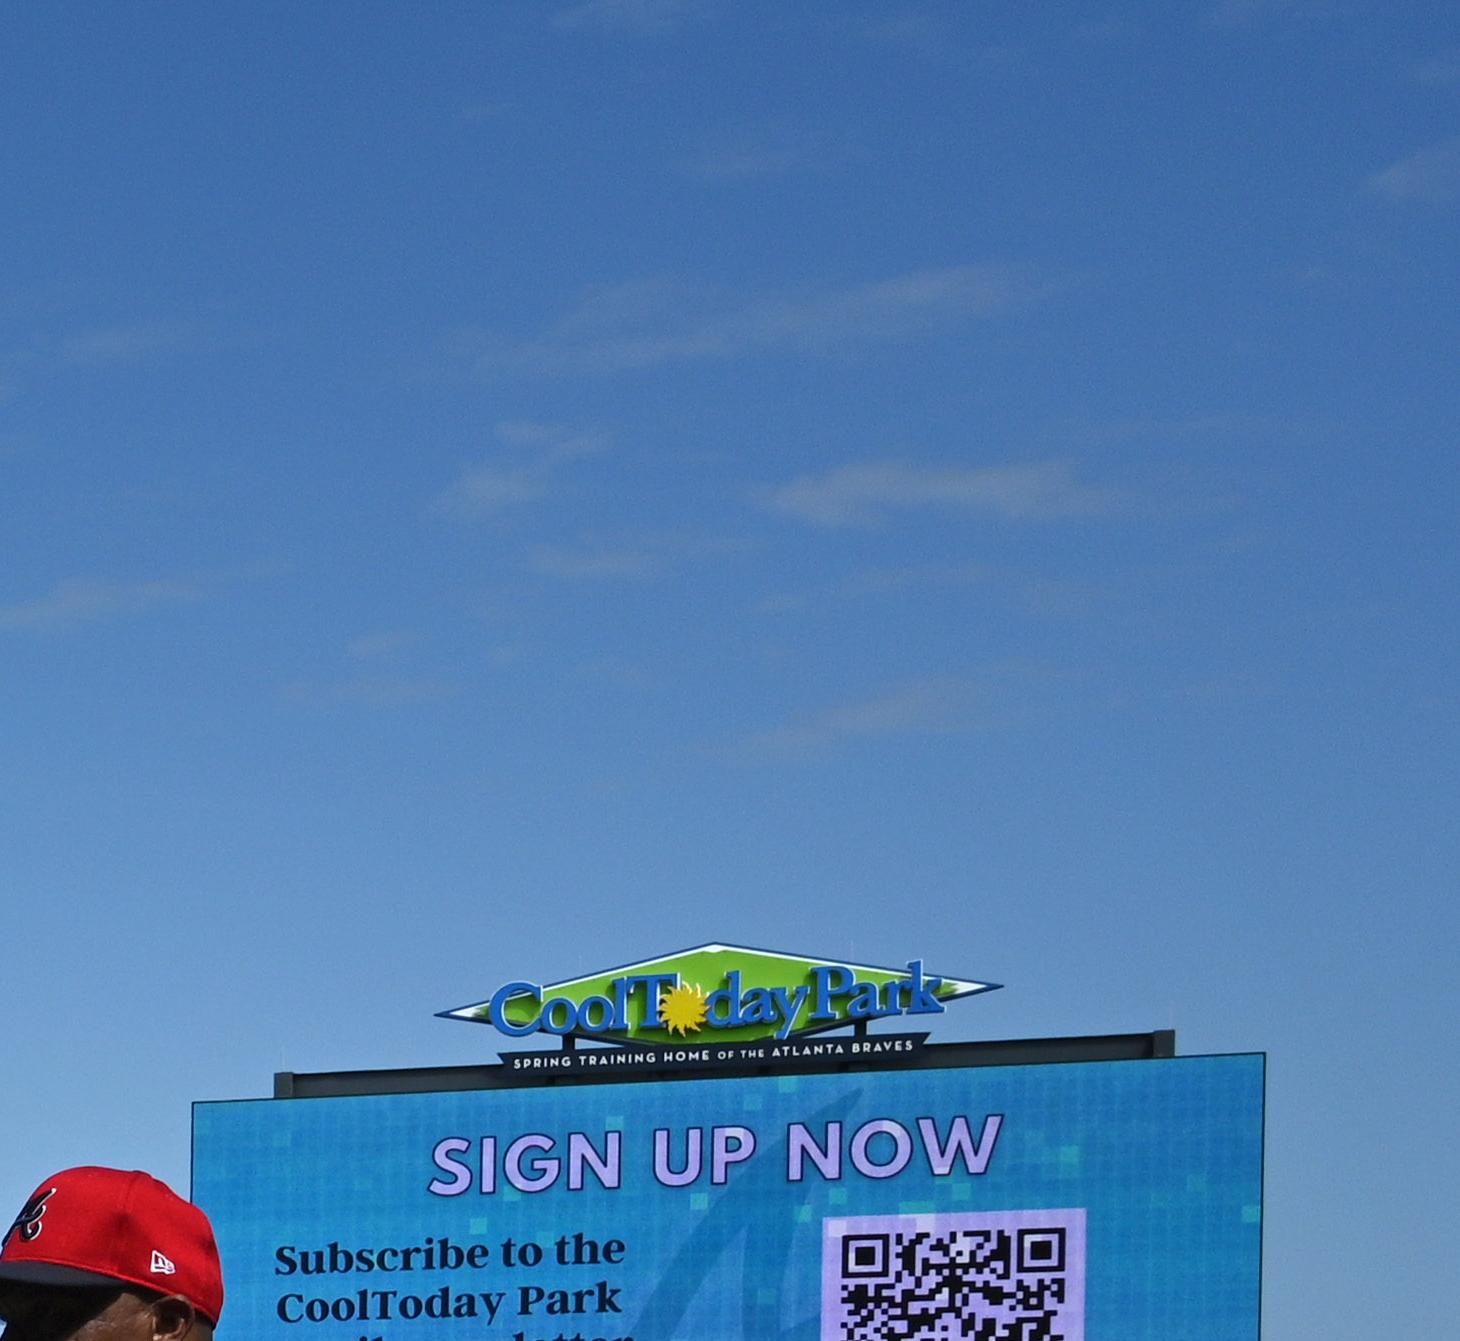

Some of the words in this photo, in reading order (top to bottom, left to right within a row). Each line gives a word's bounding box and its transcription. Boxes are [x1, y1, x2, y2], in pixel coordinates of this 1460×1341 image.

[809, 960, 946, 1020] Park
[514, 1056, 572, 1070] SPRING
[579, 1053, 657, 1065] TRAINING
[663, 1050, 710, 1062] HOME
[717, 1050, 735, 1060] OF
[740, 1049, 765, 1058] THE
[772, 1044, 844, 1057] ATLANTA
[852, 1040, 913, 1053] BRAVES
[427, 1130, 622, 1197] SIGN
[652, 1124, 756, 1187] UP
[787, 1113, 1005, 1182] NOW
[274, 1237, 489, 1275] Subscribe
[501, 1238, 543, 1268] to
[555, 1232, 626, 1265] the
[276, 1285, 507, 1326] CoolToday
[518, 1281, 622, 1316] Park
